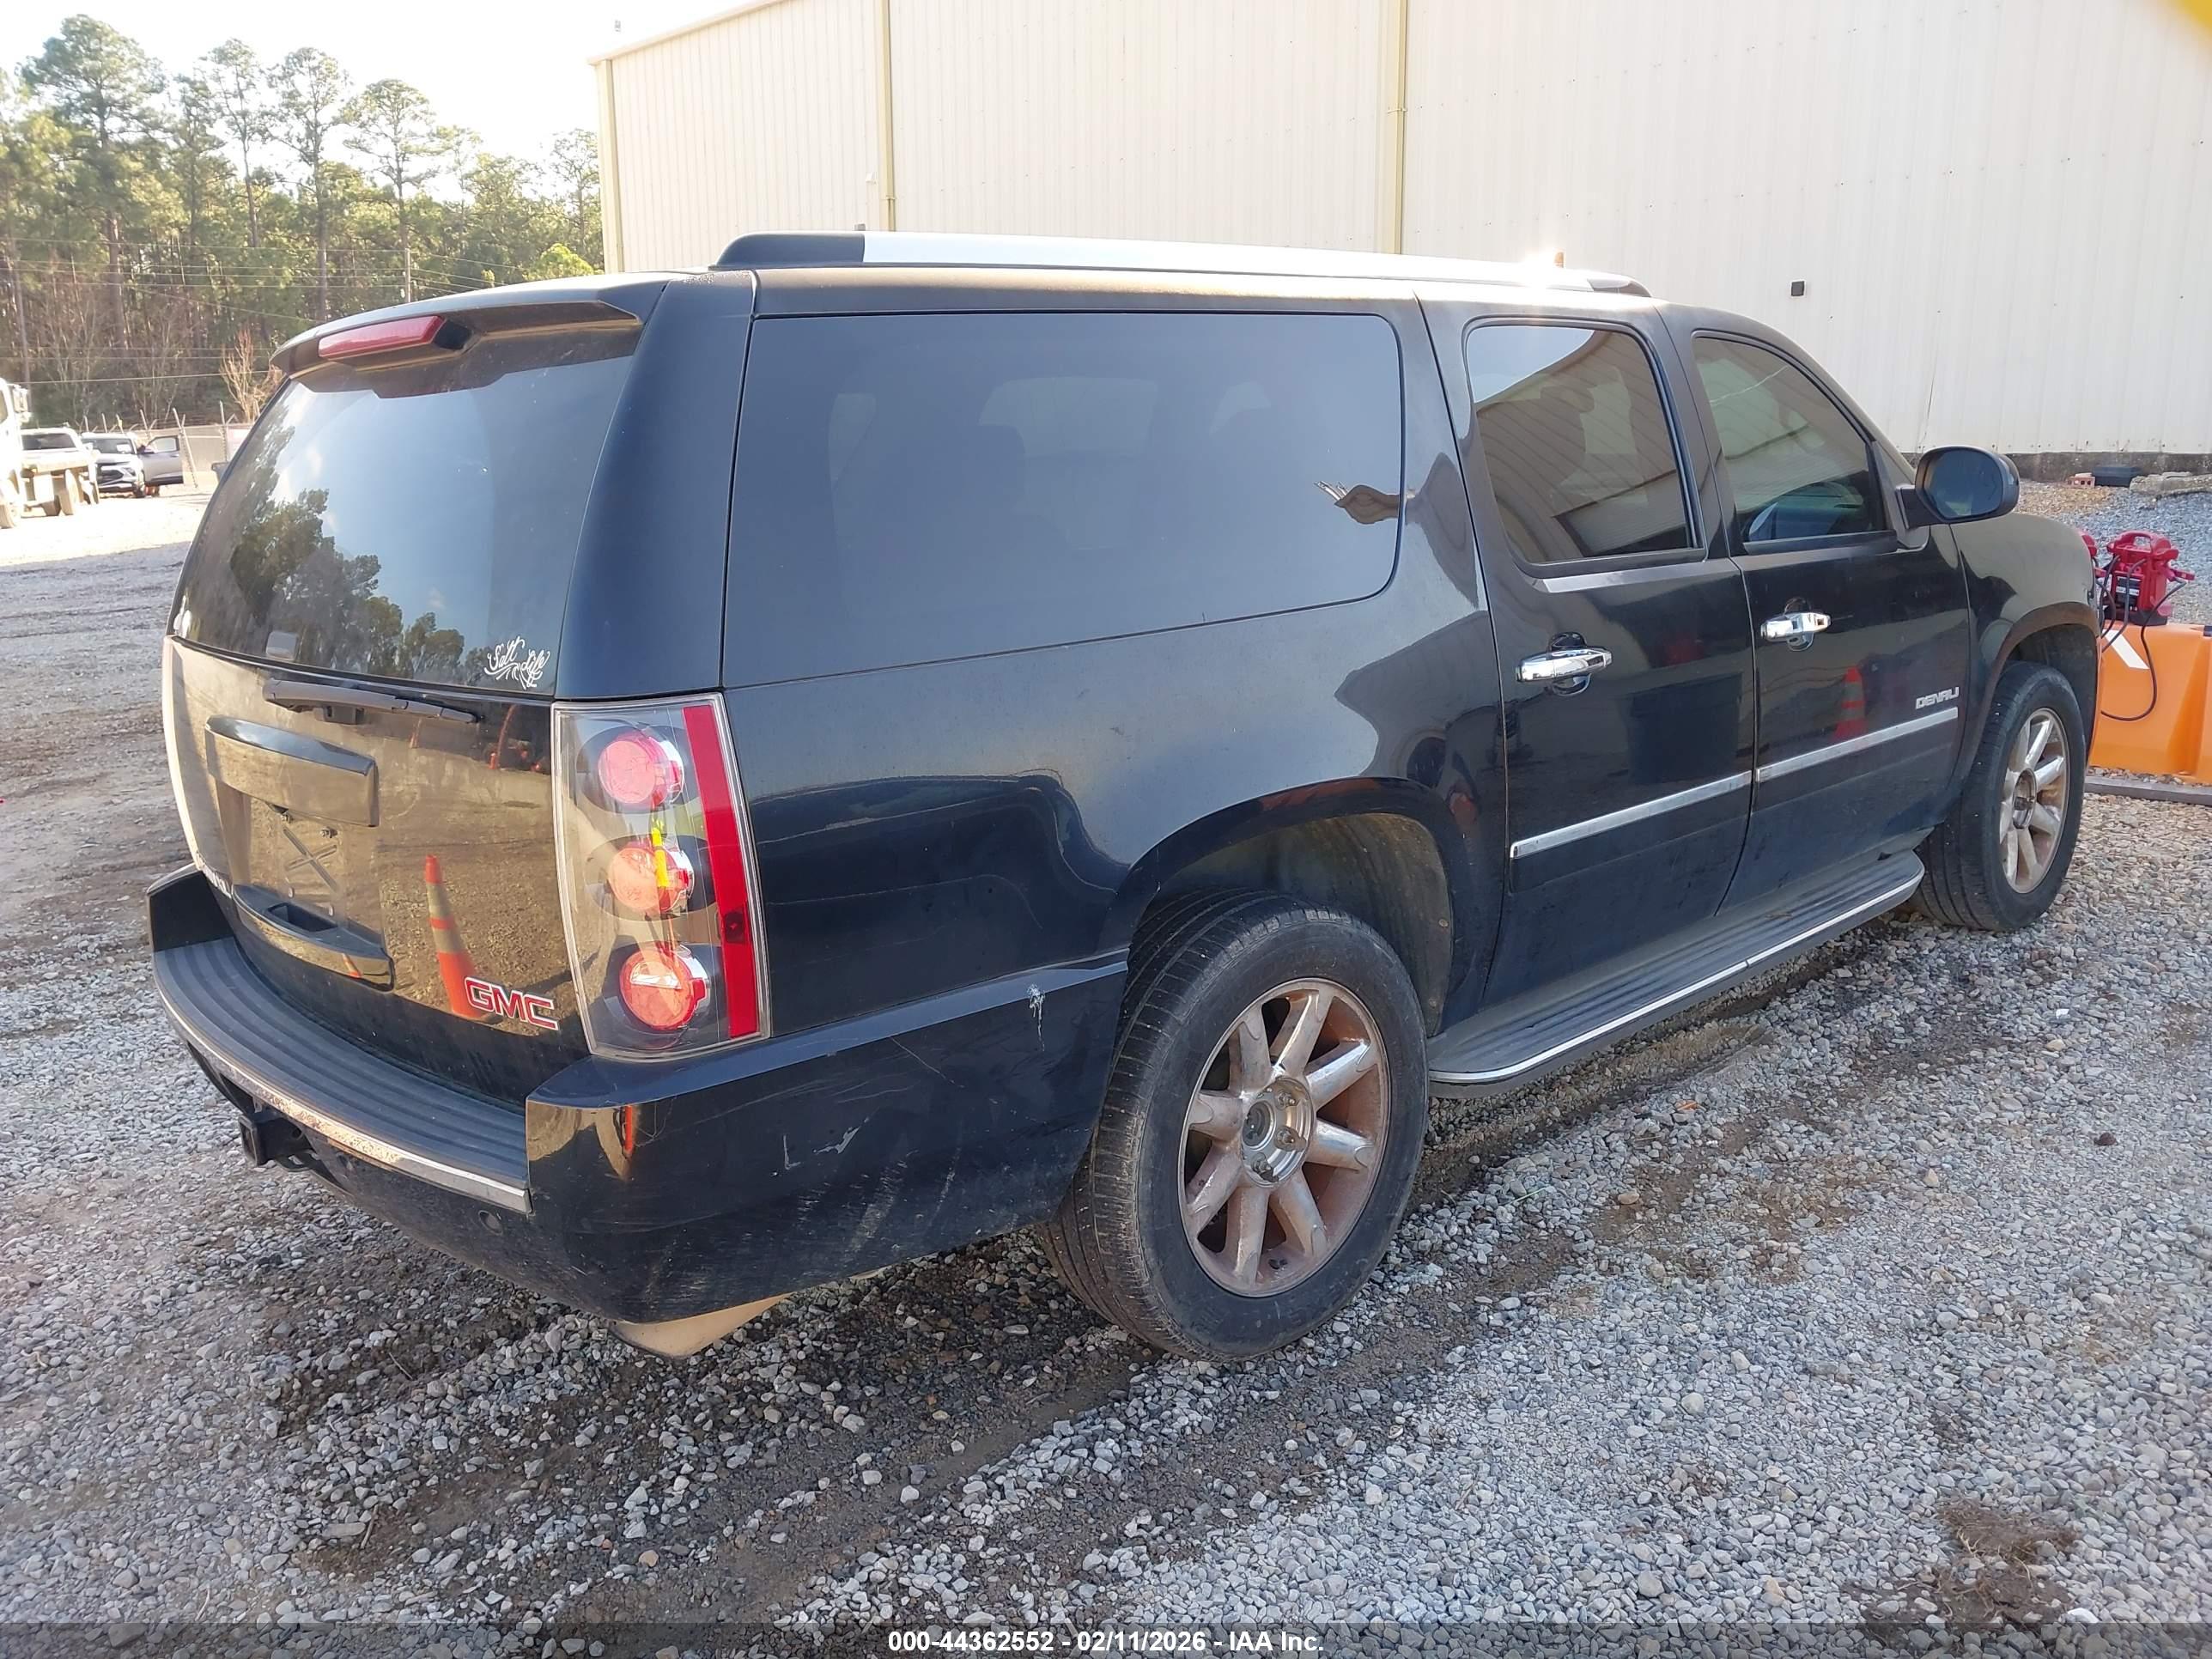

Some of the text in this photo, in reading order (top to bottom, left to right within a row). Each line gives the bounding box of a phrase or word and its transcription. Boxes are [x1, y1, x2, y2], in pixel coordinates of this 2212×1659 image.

[486, 635, 550, 688] Salt Life
[1915, 686, 1960, 709] DENALI
[464, 976, 559, 1030] GMC
